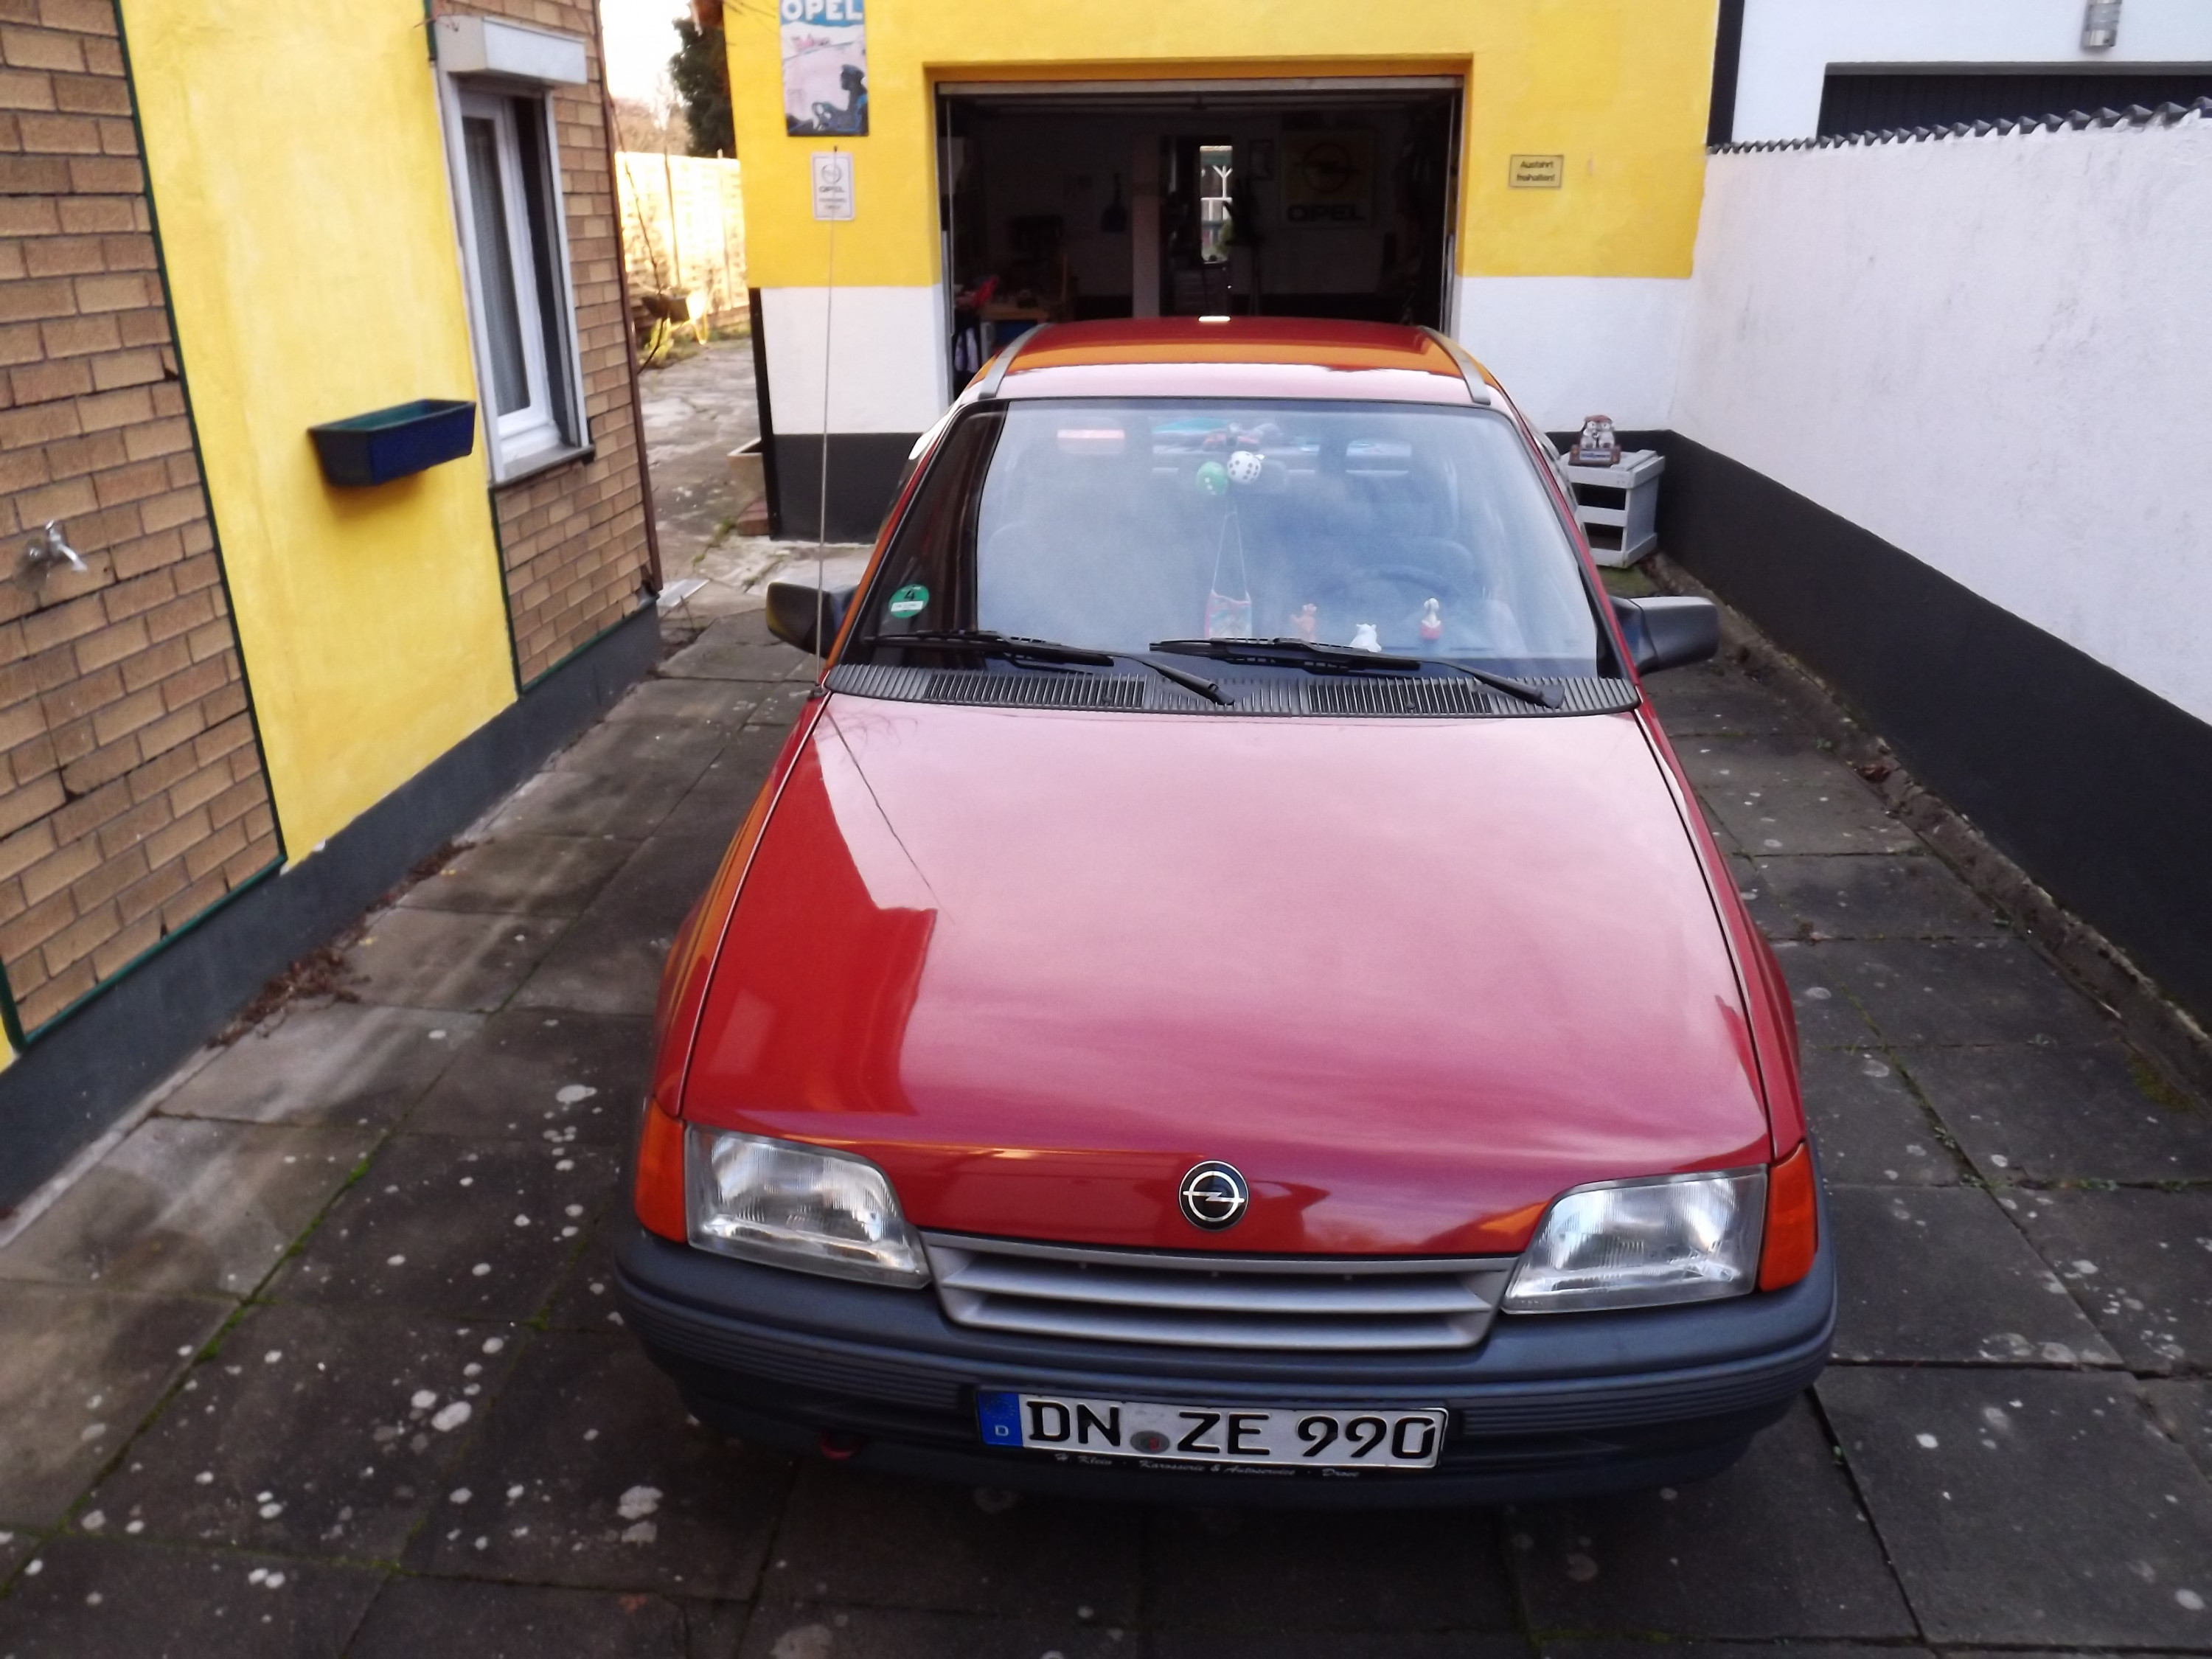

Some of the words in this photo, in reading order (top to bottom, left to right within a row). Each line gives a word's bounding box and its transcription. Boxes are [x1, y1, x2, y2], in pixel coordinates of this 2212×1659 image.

[780, 0, 864, 21] OPEL
[1287, 204, 1366, 222] OPEL
[904, 589, 915, 601] 4
[995, 1425, 1009, 1436] D
[1026, 1400, 1121, 1446] DN
[1177, 1411, 1270, 1455] ZE
[1296, 1415, 1436, 1459] 990
